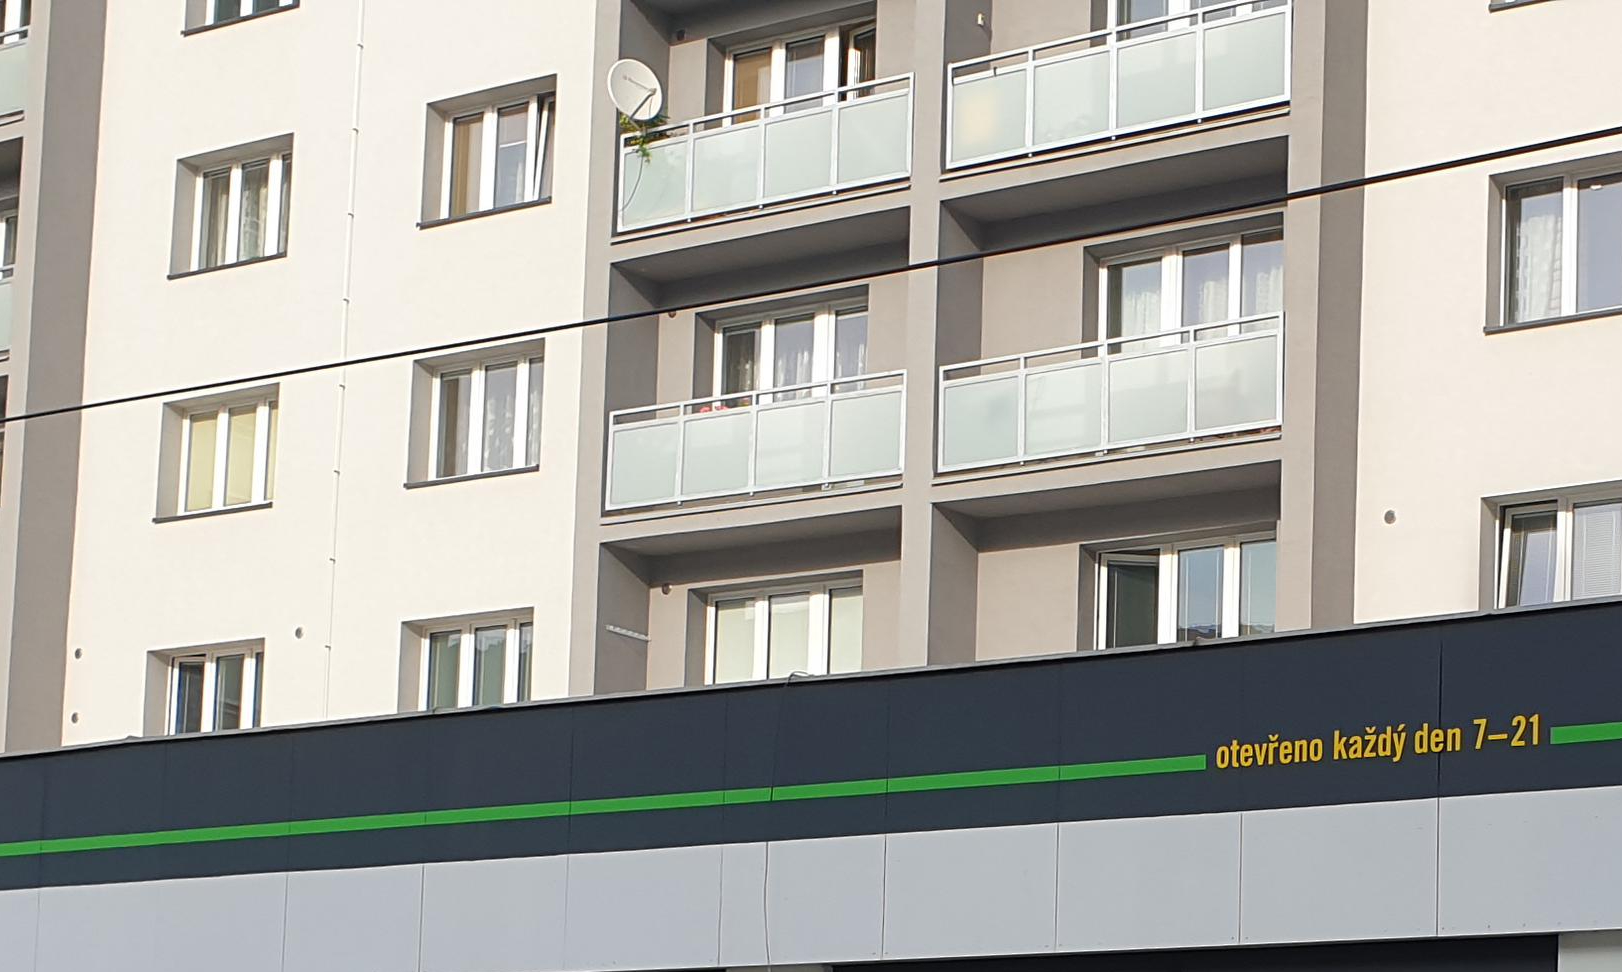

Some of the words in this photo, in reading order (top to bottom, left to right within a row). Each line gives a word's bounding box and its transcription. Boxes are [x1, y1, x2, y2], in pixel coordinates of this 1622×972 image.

[1216, 734, 1323, 769] otevřeno
[1333, 723, 1406, 762] každý
[1414, 723, 1461, 754] den
